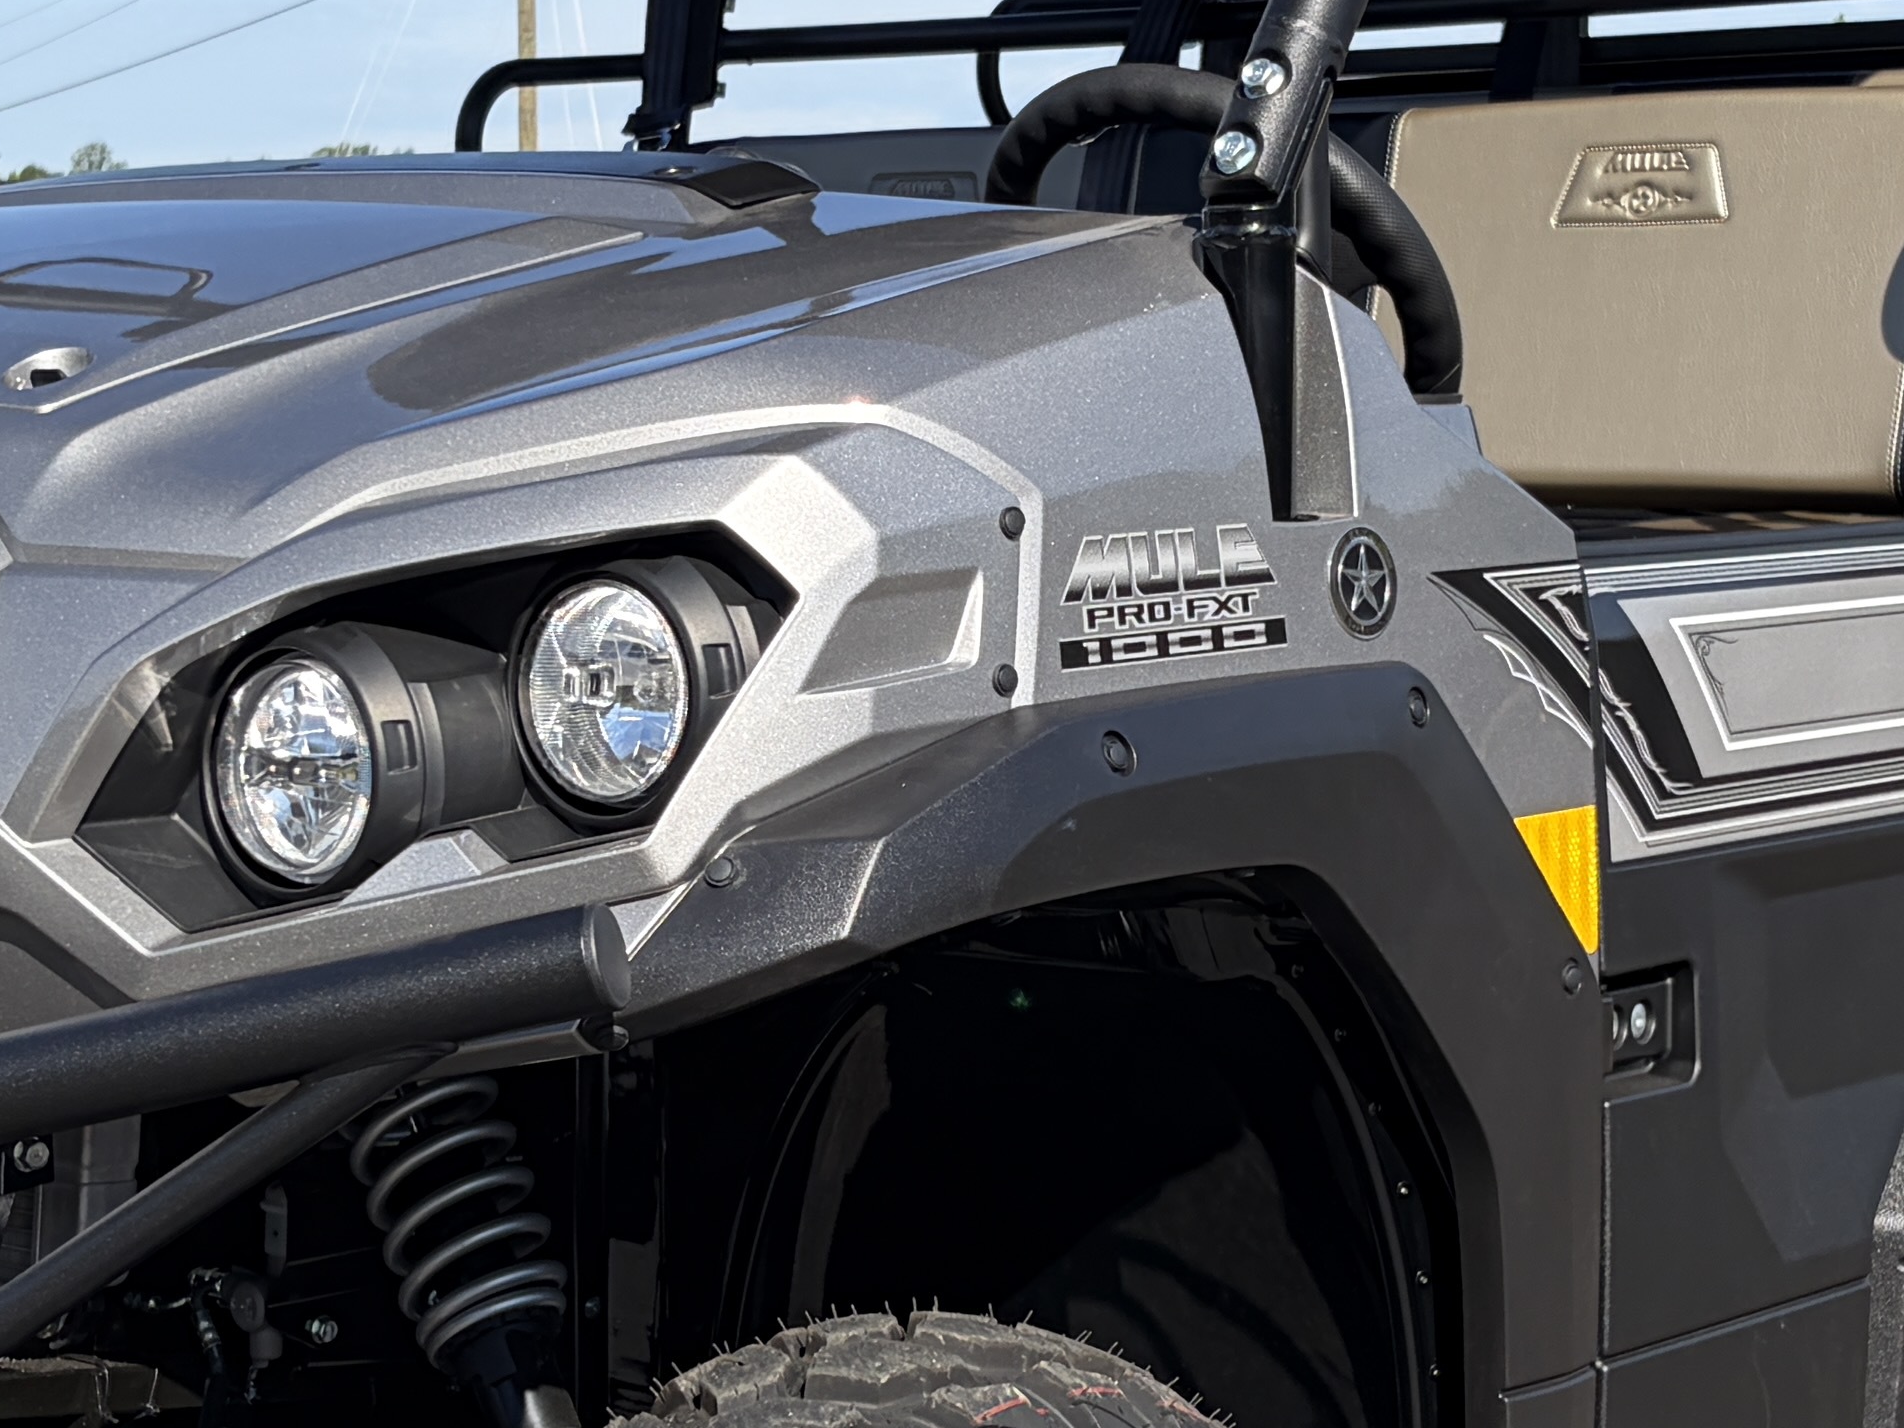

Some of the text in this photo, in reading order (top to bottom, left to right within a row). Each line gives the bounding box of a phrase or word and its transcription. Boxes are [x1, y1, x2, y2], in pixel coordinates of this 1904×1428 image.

[1060, 523, 1278, 606] MULE
[1083, 589, 1260, 633] PRO-FXT
[1082, 623, 1267, 665] 1000
